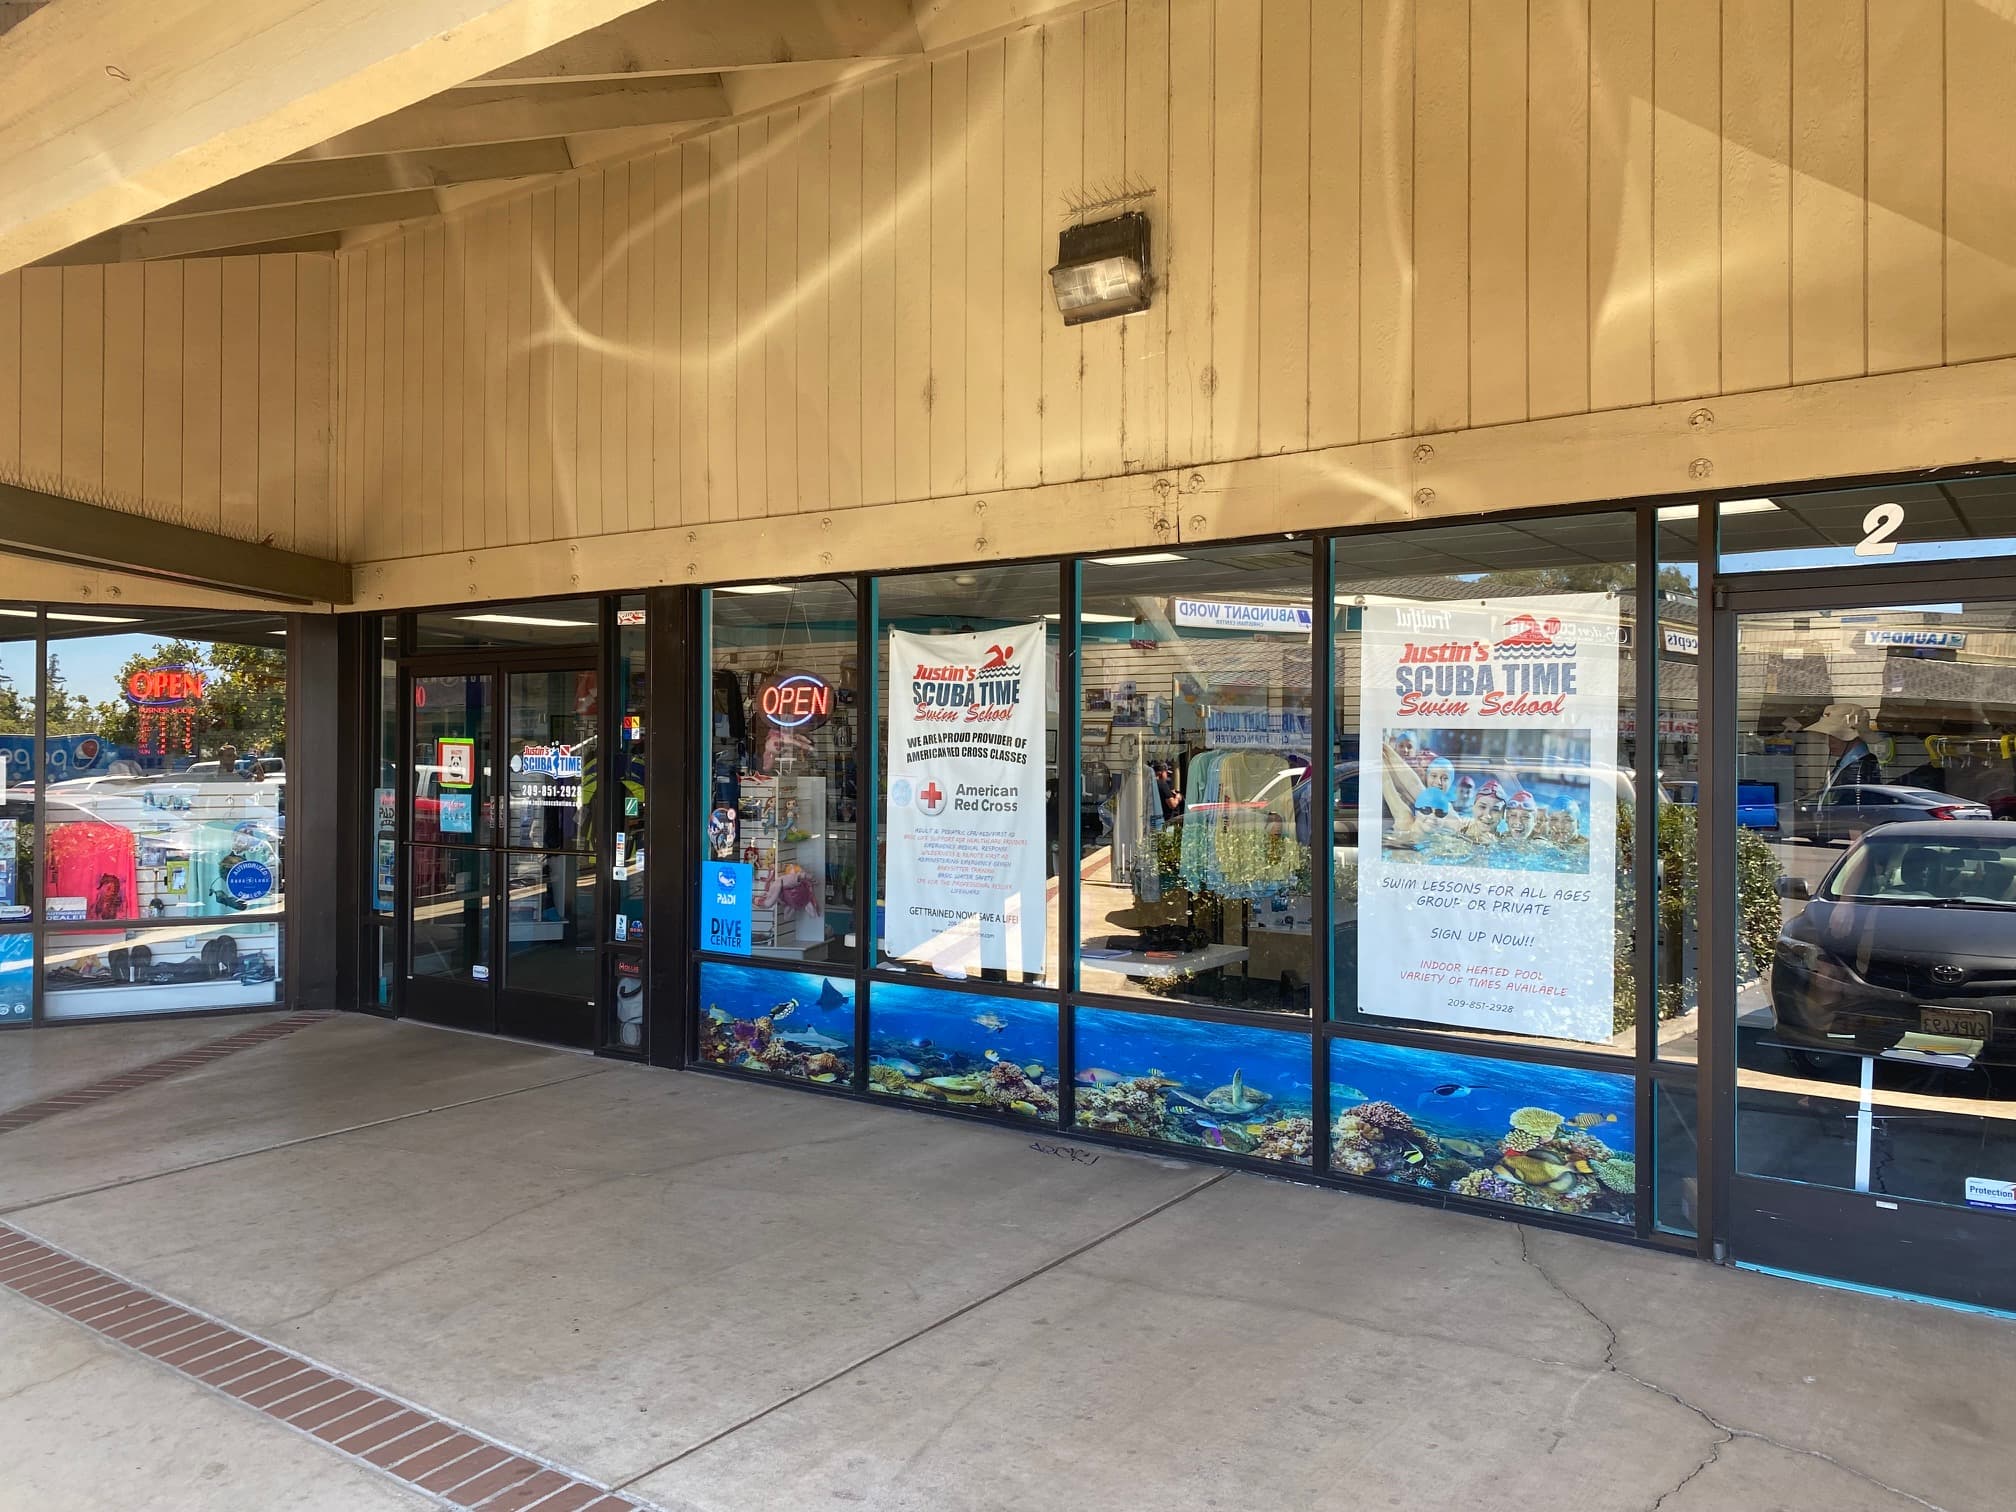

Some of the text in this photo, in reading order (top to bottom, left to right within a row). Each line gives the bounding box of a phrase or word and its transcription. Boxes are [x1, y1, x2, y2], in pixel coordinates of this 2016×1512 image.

[1855, 503, 1904, 556] 2
[1399, 642, 1490, 663] Justin's
[913, 664, 976, 681] Justin's
[1395, 662, 1577, 697] SCUBA TIME
[129, 672, 202, 699] OPEN
[913, 679, 1020, 707] SCUBA TIME
[762, 686, 828, 715] OPEN
[1397, 691, 1566, 716] Swim School
[914, 702, 1014, 723] Swim School
[907, 736, 921, 748] WE
[923, 733, 937, 745] ARE
[942, 732, 970, 744] PROUD
[972, 732, 1012, 747] PROVIDER
[1014, 737, 1027, 749] OF
[524, 745, 550, 756] Justin's
[907, 747, 1027, 765] AMERICAN RED CROSS CLASSES
[523, 756, 581, 772] SCUBA TIME
[956, 783, 1018, 797] American
[379, 807, 395, 819] PAD
[955, 798, 1018, 812] Red Cross
[1382, 877, 1591, 902] SWIM LESSONS FOR ALL AGES
[717, 893, 736, 905] PADI
[1467, 900, 1486, 911] OR
[1492, 900, 1551, 915] PRIVATE
[909, 906, 923, 916] GET
[924, 908, 954, 919] TRAINED
[979, 912, 994, 922] SAVE
[995, 914, 1001, 922] A
[711, 917, 742, 938] DIVE
[710, 935, 741, 948] CENTER
[1431, 927, 1535, 947] SIGN UP NOW!!
[1420, 960, 1543, 980] INDOOR HEATED POOL
[1400, 971, 1569, 996] VARIETY OF TIMES AVAILABLE
[1447, 998, 1515, 1013] 209-851-2928
[1970, 1185, 2012, 1198] Protection
